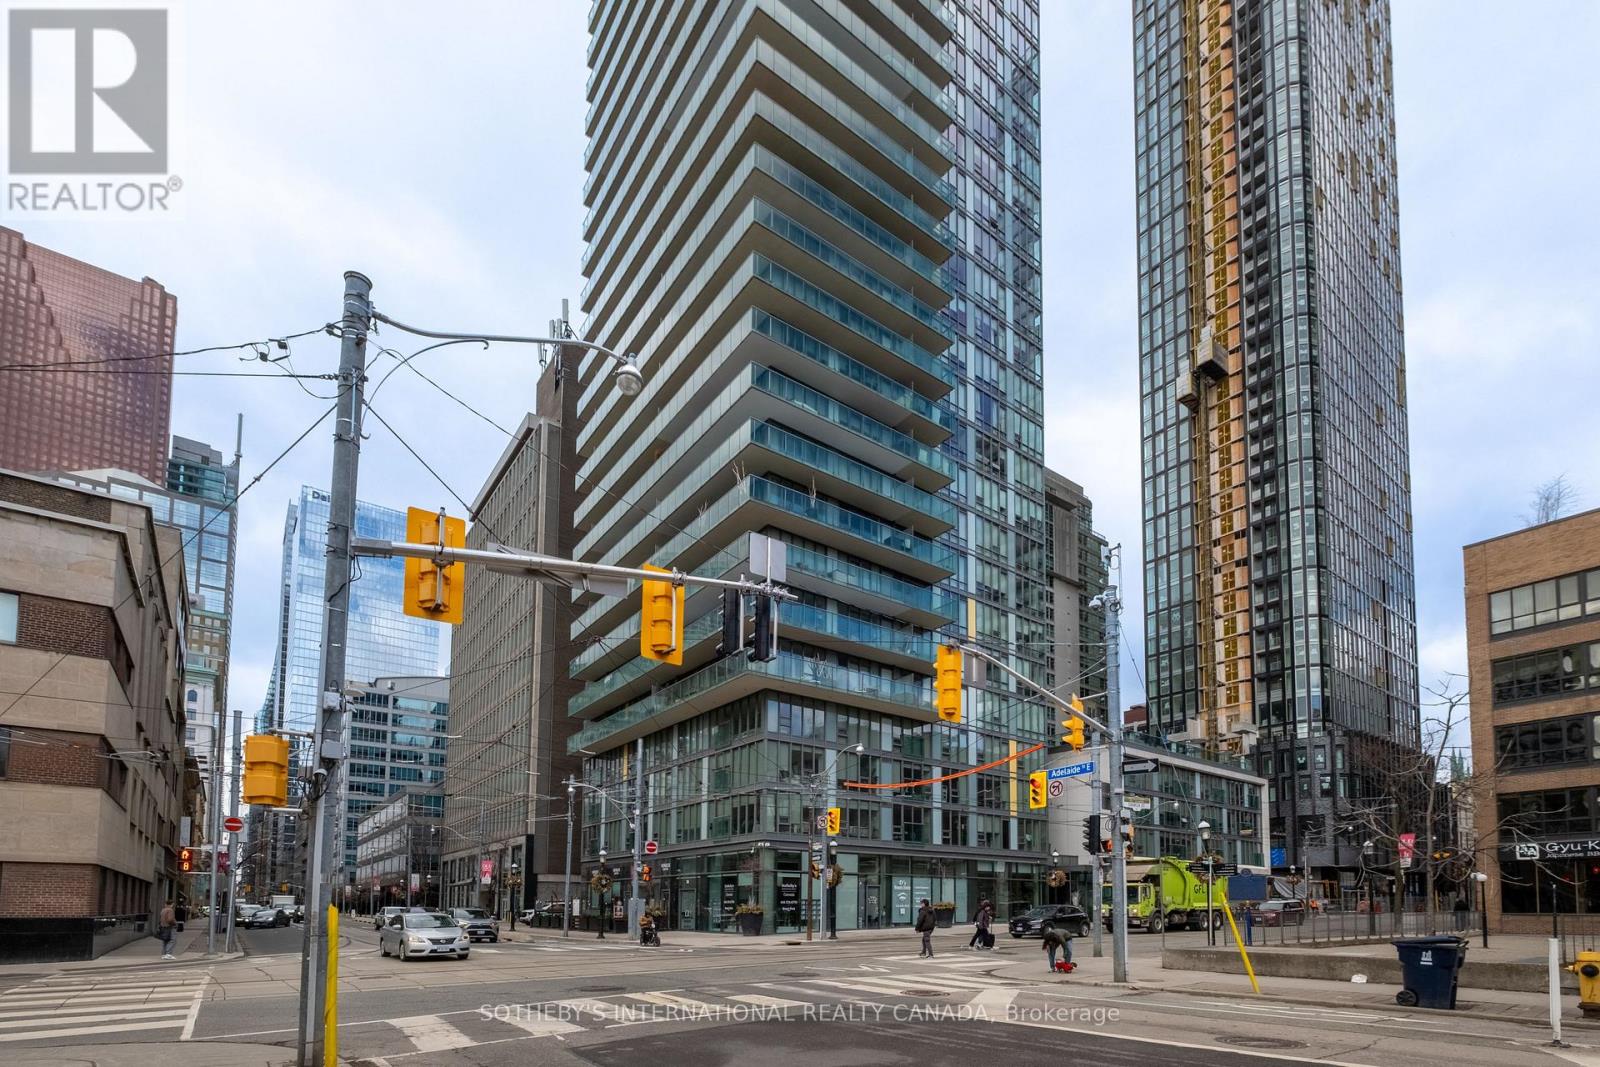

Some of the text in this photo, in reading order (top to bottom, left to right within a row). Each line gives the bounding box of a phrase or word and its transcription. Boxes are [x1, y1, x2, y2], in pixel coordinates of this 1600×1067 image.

[1051, 763, 1091, 778] Adelaide E
[1193, 884, 1206, 894] GFL
